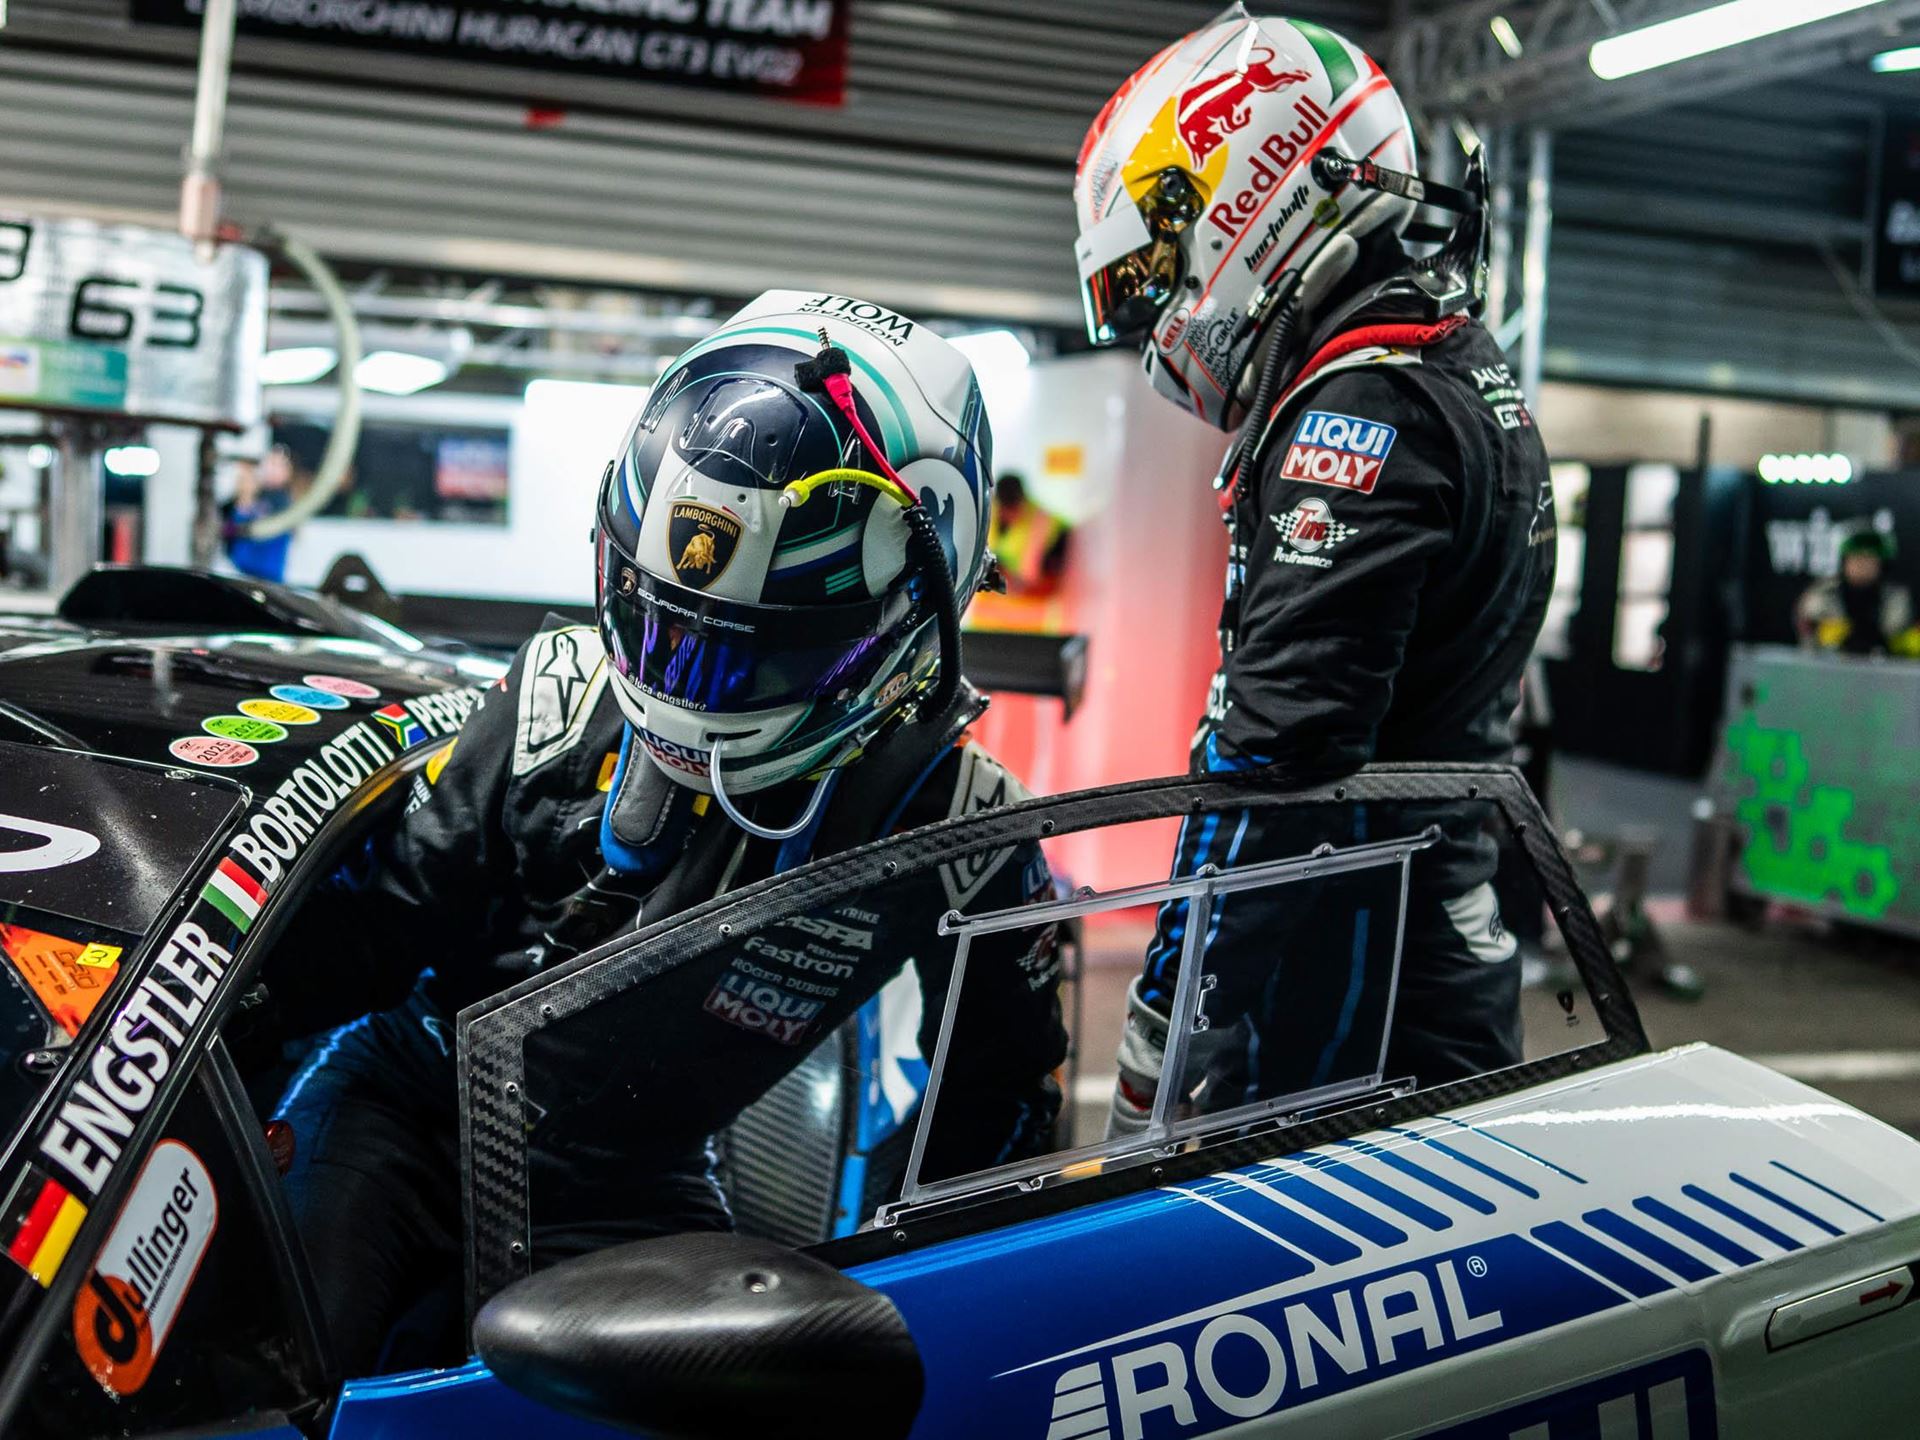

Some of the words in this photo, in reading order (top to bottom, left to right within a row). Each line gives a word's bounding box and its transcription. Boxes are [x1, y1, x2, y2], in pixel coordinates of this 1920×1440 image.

[1208, 156, 1279, 238] Red
[1260, 94, 1330, 170] Bull
[68, 276, 206, 348] 63
[804, 295, 914, 340] WOLF
[1297, 415, 1389, 456] LIQUI
[1286, 447, 1380, 487] MOLY
[673, 506, 738, 539] LAMBORGHINI
[637, 587, 698, 620] SQUADRA
[702, 615, 756, 633] CORSE
[197, 741, 231, 761] 2025
[642, 728, 710, 764] LIQUI
[645, 742, 711, 777] MOLY
[230, 722, 394, 884] BORTOLOTTI
[731, 957, 782, 984] ROGER
[785, 977, 839, 998] DUBUIS
[744, 936, 854, 978] Fastron
[711, 991, 807, 1042] MOLY
[724, 974, 818, 1020] LIQUI
[40, 922, 234, 1196] ENGSTLER
[1111, 1259, 1504, 1440] RONAL
